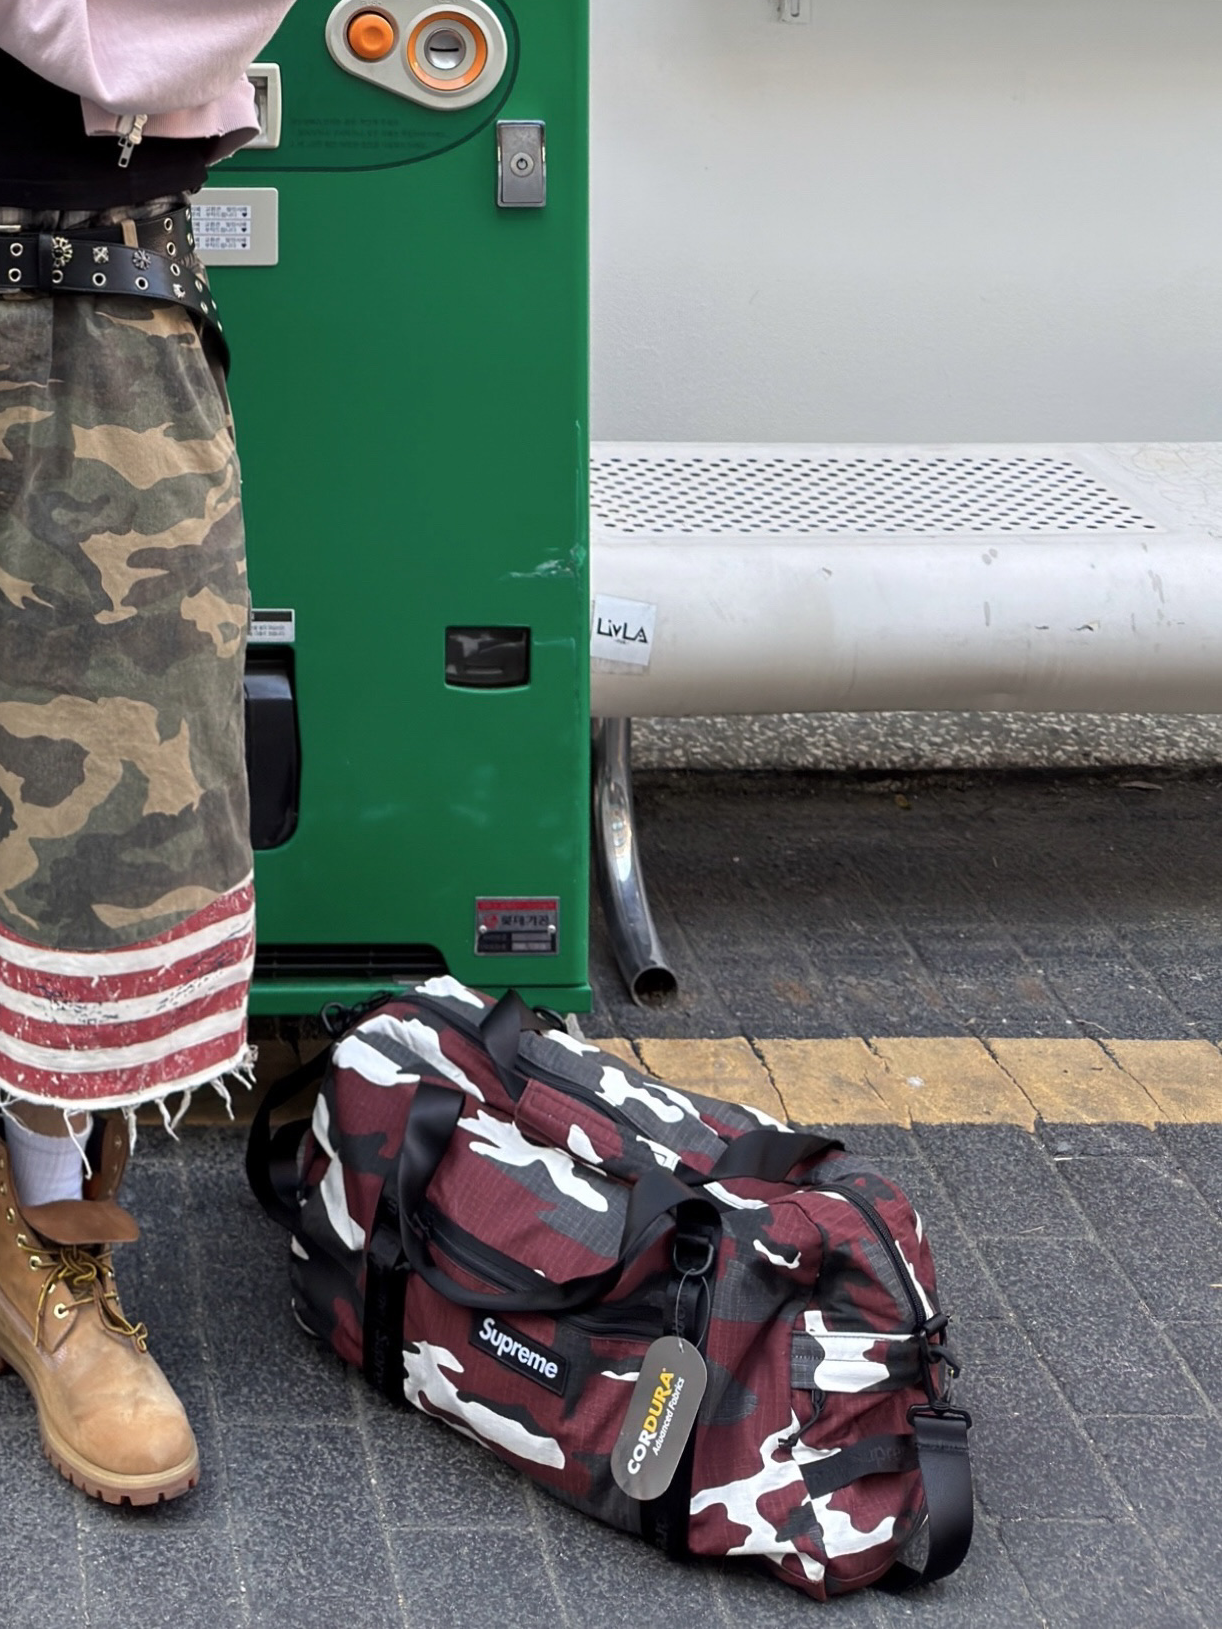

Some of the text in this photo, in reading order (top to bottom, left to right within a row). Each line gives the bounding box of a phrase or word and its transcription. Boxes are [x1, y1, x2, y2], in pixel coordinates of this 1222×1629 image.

[479, 1317, 559, 1379] Supreme
[628, 1368, 675, 1475] CORDURA
[652, 1376, 686, 1457] Advanced Fabrics
